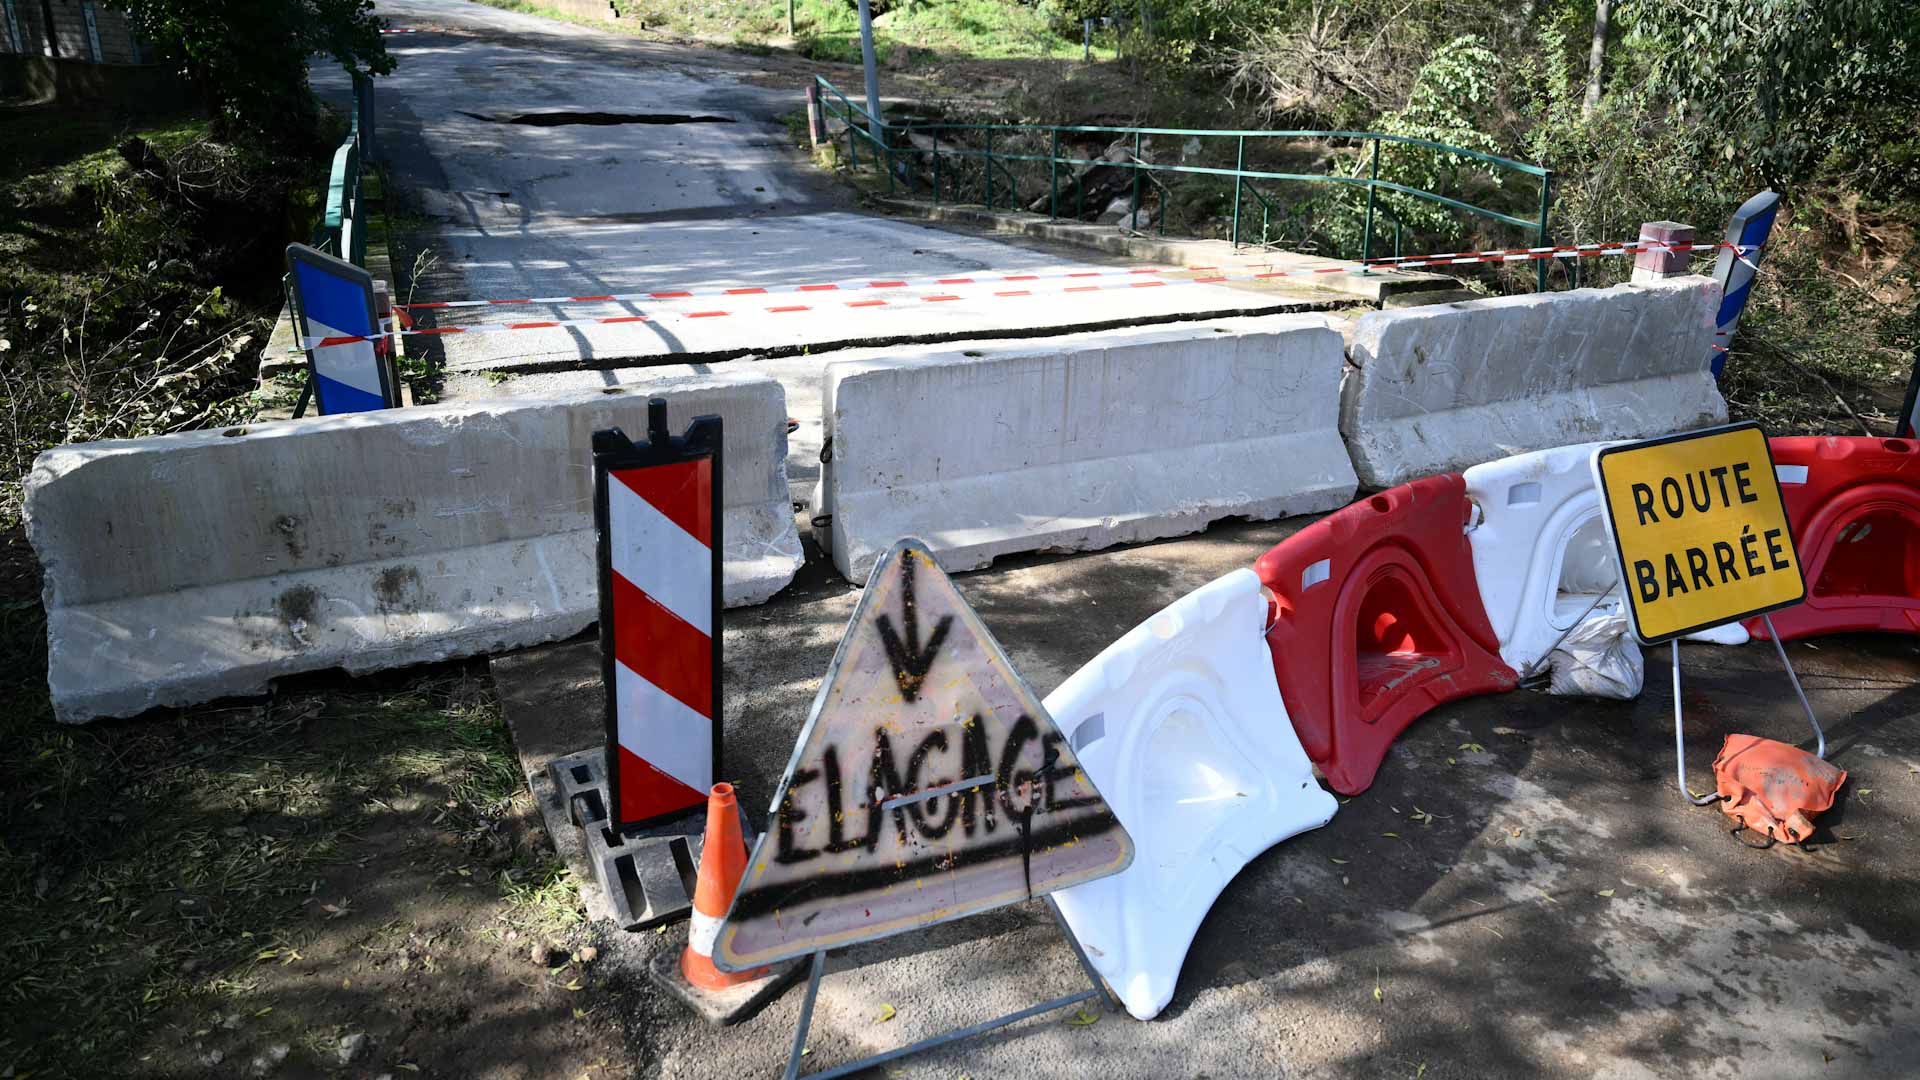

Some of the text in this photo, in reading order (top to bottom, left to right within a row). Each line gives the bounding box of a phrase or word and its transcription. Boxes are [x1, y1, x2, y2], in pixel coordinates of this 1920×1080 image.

[1631, 462, 1758, 526] ROUTE
[1633, 524, 1790, 604] BARRÉE
[774, 713, 1104, 864] ELAGAGE
